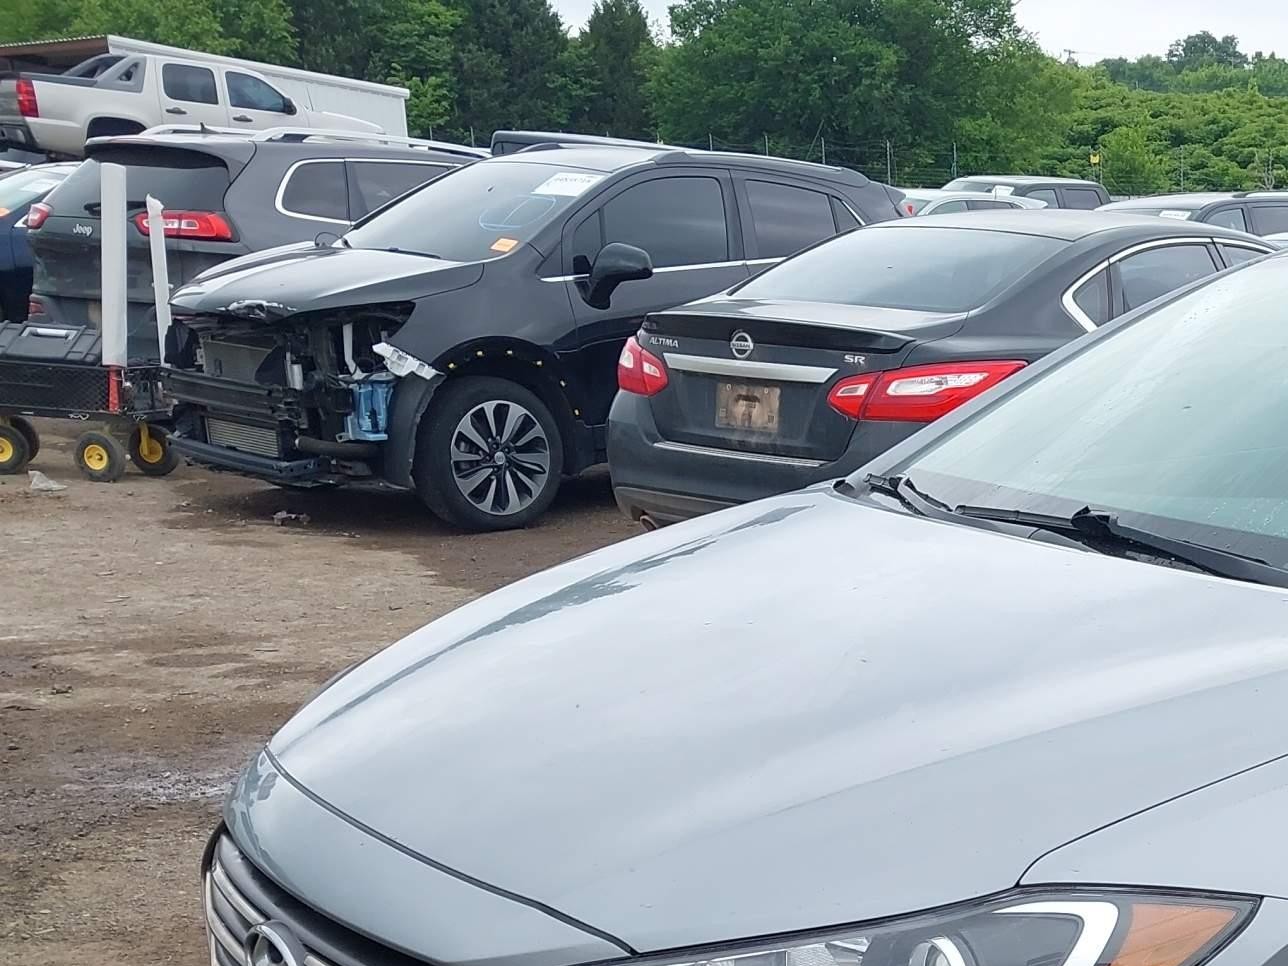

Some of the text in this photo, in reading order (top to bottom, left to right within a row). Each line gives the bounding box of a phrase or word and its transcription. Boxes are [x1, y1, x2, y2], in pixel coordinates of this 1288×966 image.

[73, 223, 92, 236] Jeep
[649, 337, 679, 348] ALTIMA
[844, 354, 866, 365] SR
